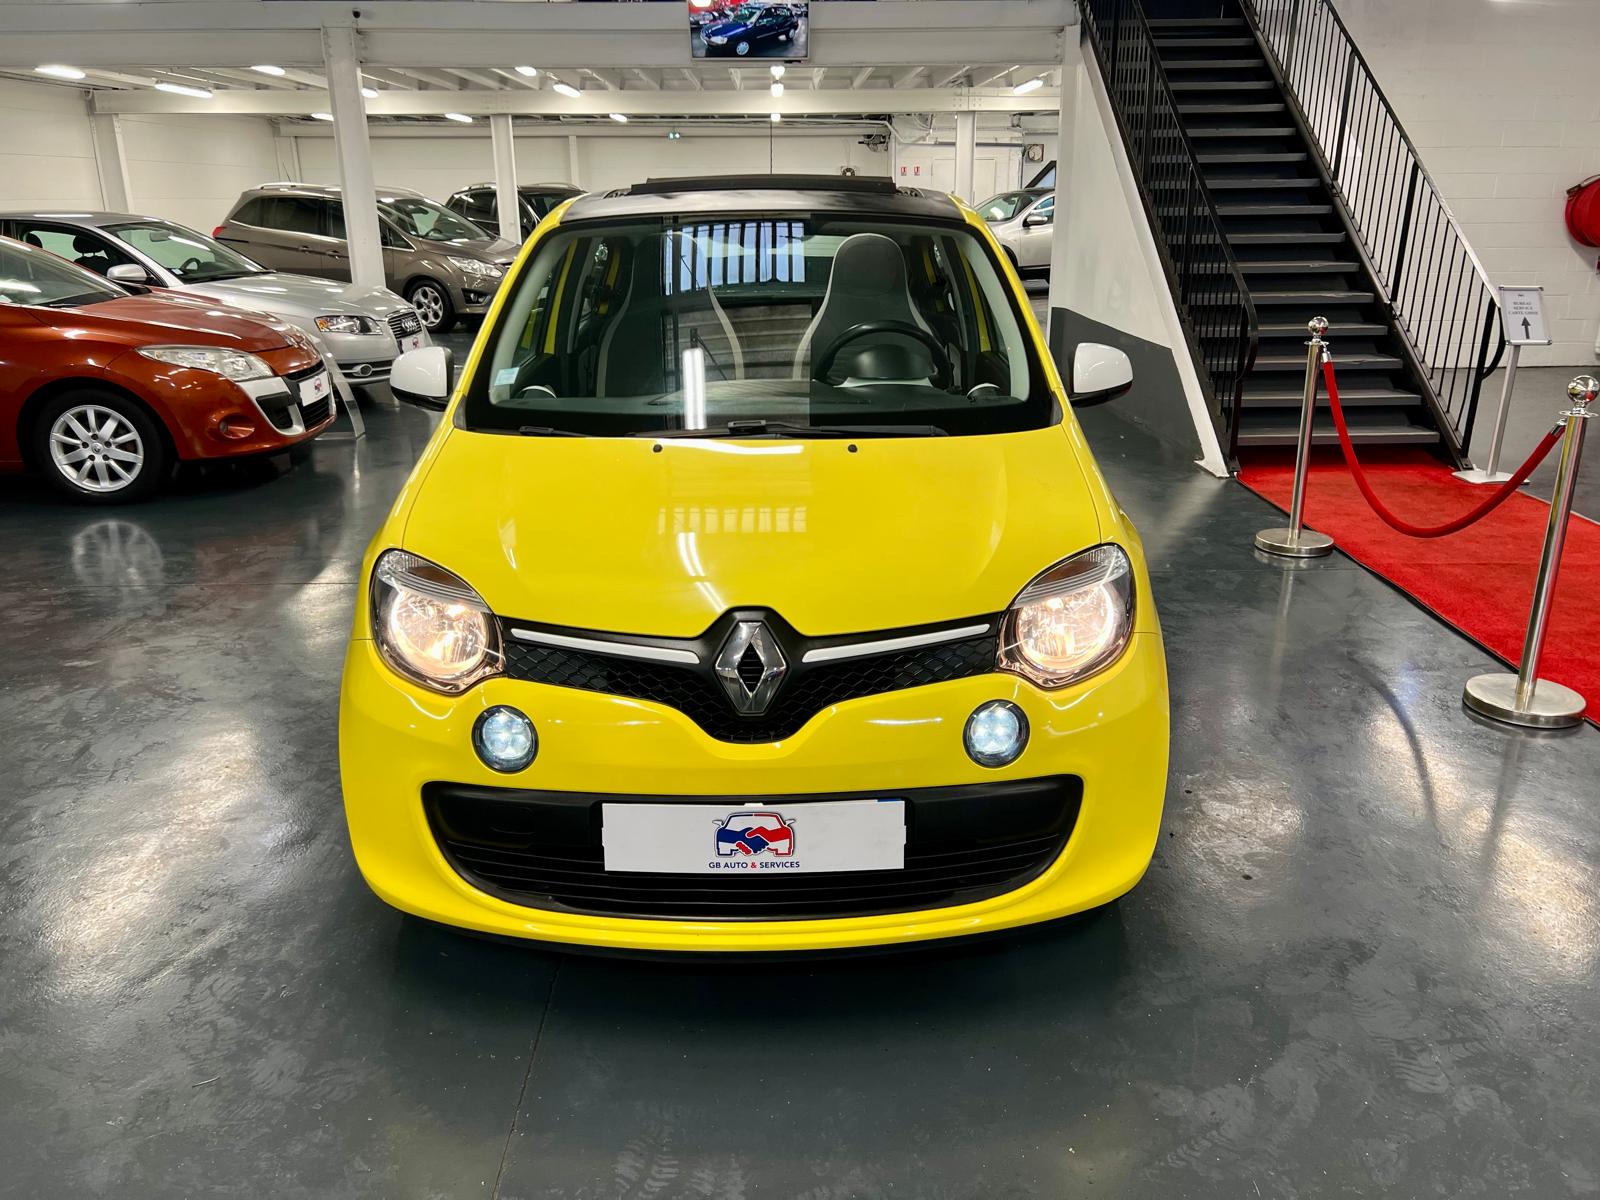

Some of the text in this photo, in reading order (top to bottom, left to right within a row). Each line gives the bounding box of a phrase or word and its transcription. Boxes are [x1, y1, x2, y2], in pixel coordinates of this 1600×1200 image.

[708, 861, 800, 869] GB AUTO & SERVICES
